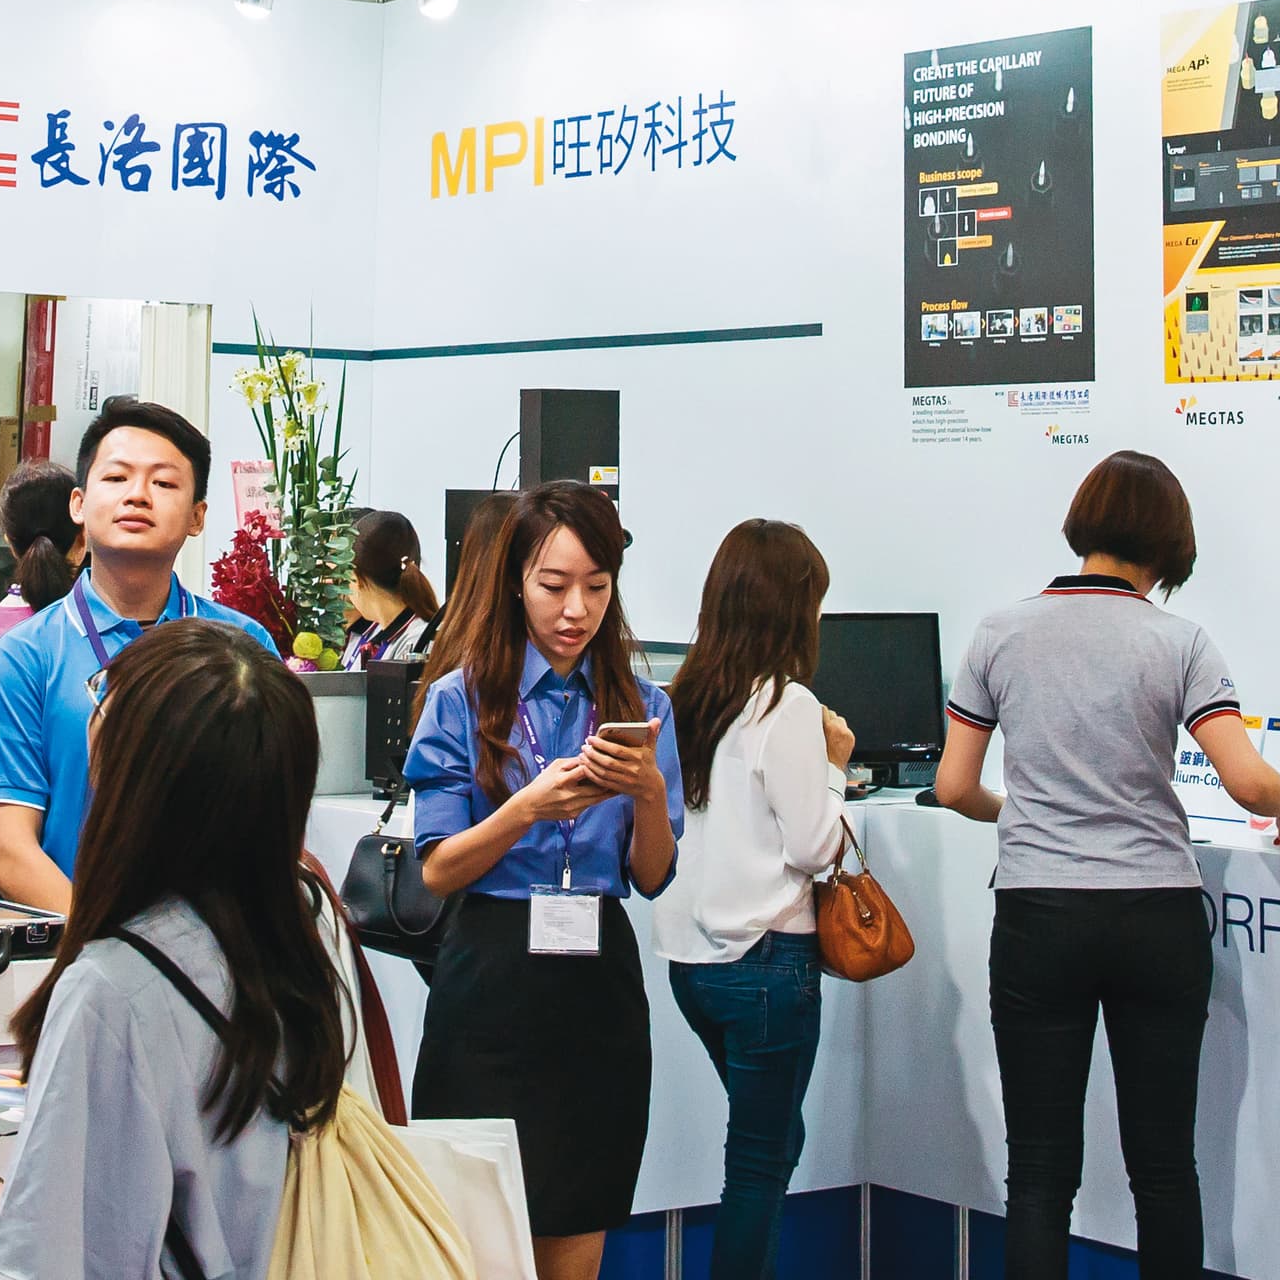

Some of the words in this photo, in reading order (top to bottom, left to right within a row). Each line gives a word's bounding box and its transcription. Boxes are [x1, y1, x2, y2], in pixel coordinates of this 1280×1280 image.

[913, 63, 955, 83] CREATE
[955, 60, 978, 77] THE
[979, 50, 1042, 74] CAPILLARY
[913, 84, 957, 105] FUTURE
[958, 82, 974, 99] OF
[913, 101, 1005, 127] HIGH-PRECISION
[429, 116, 545, 200] MPI
[551, 89, 739, 181] 旺矽科技
[913, 128, 966, 149] BONDING
[919, 170, 956, 184] Business
[957, 168, 983, 181] scope
[921, 300, 950, 313] Process
[912, 395, 947, 406] MEGTAS
[1186, 411, 1244, 426] MEGTAS
[1052, 434, 1089, 444] MEGTAS
